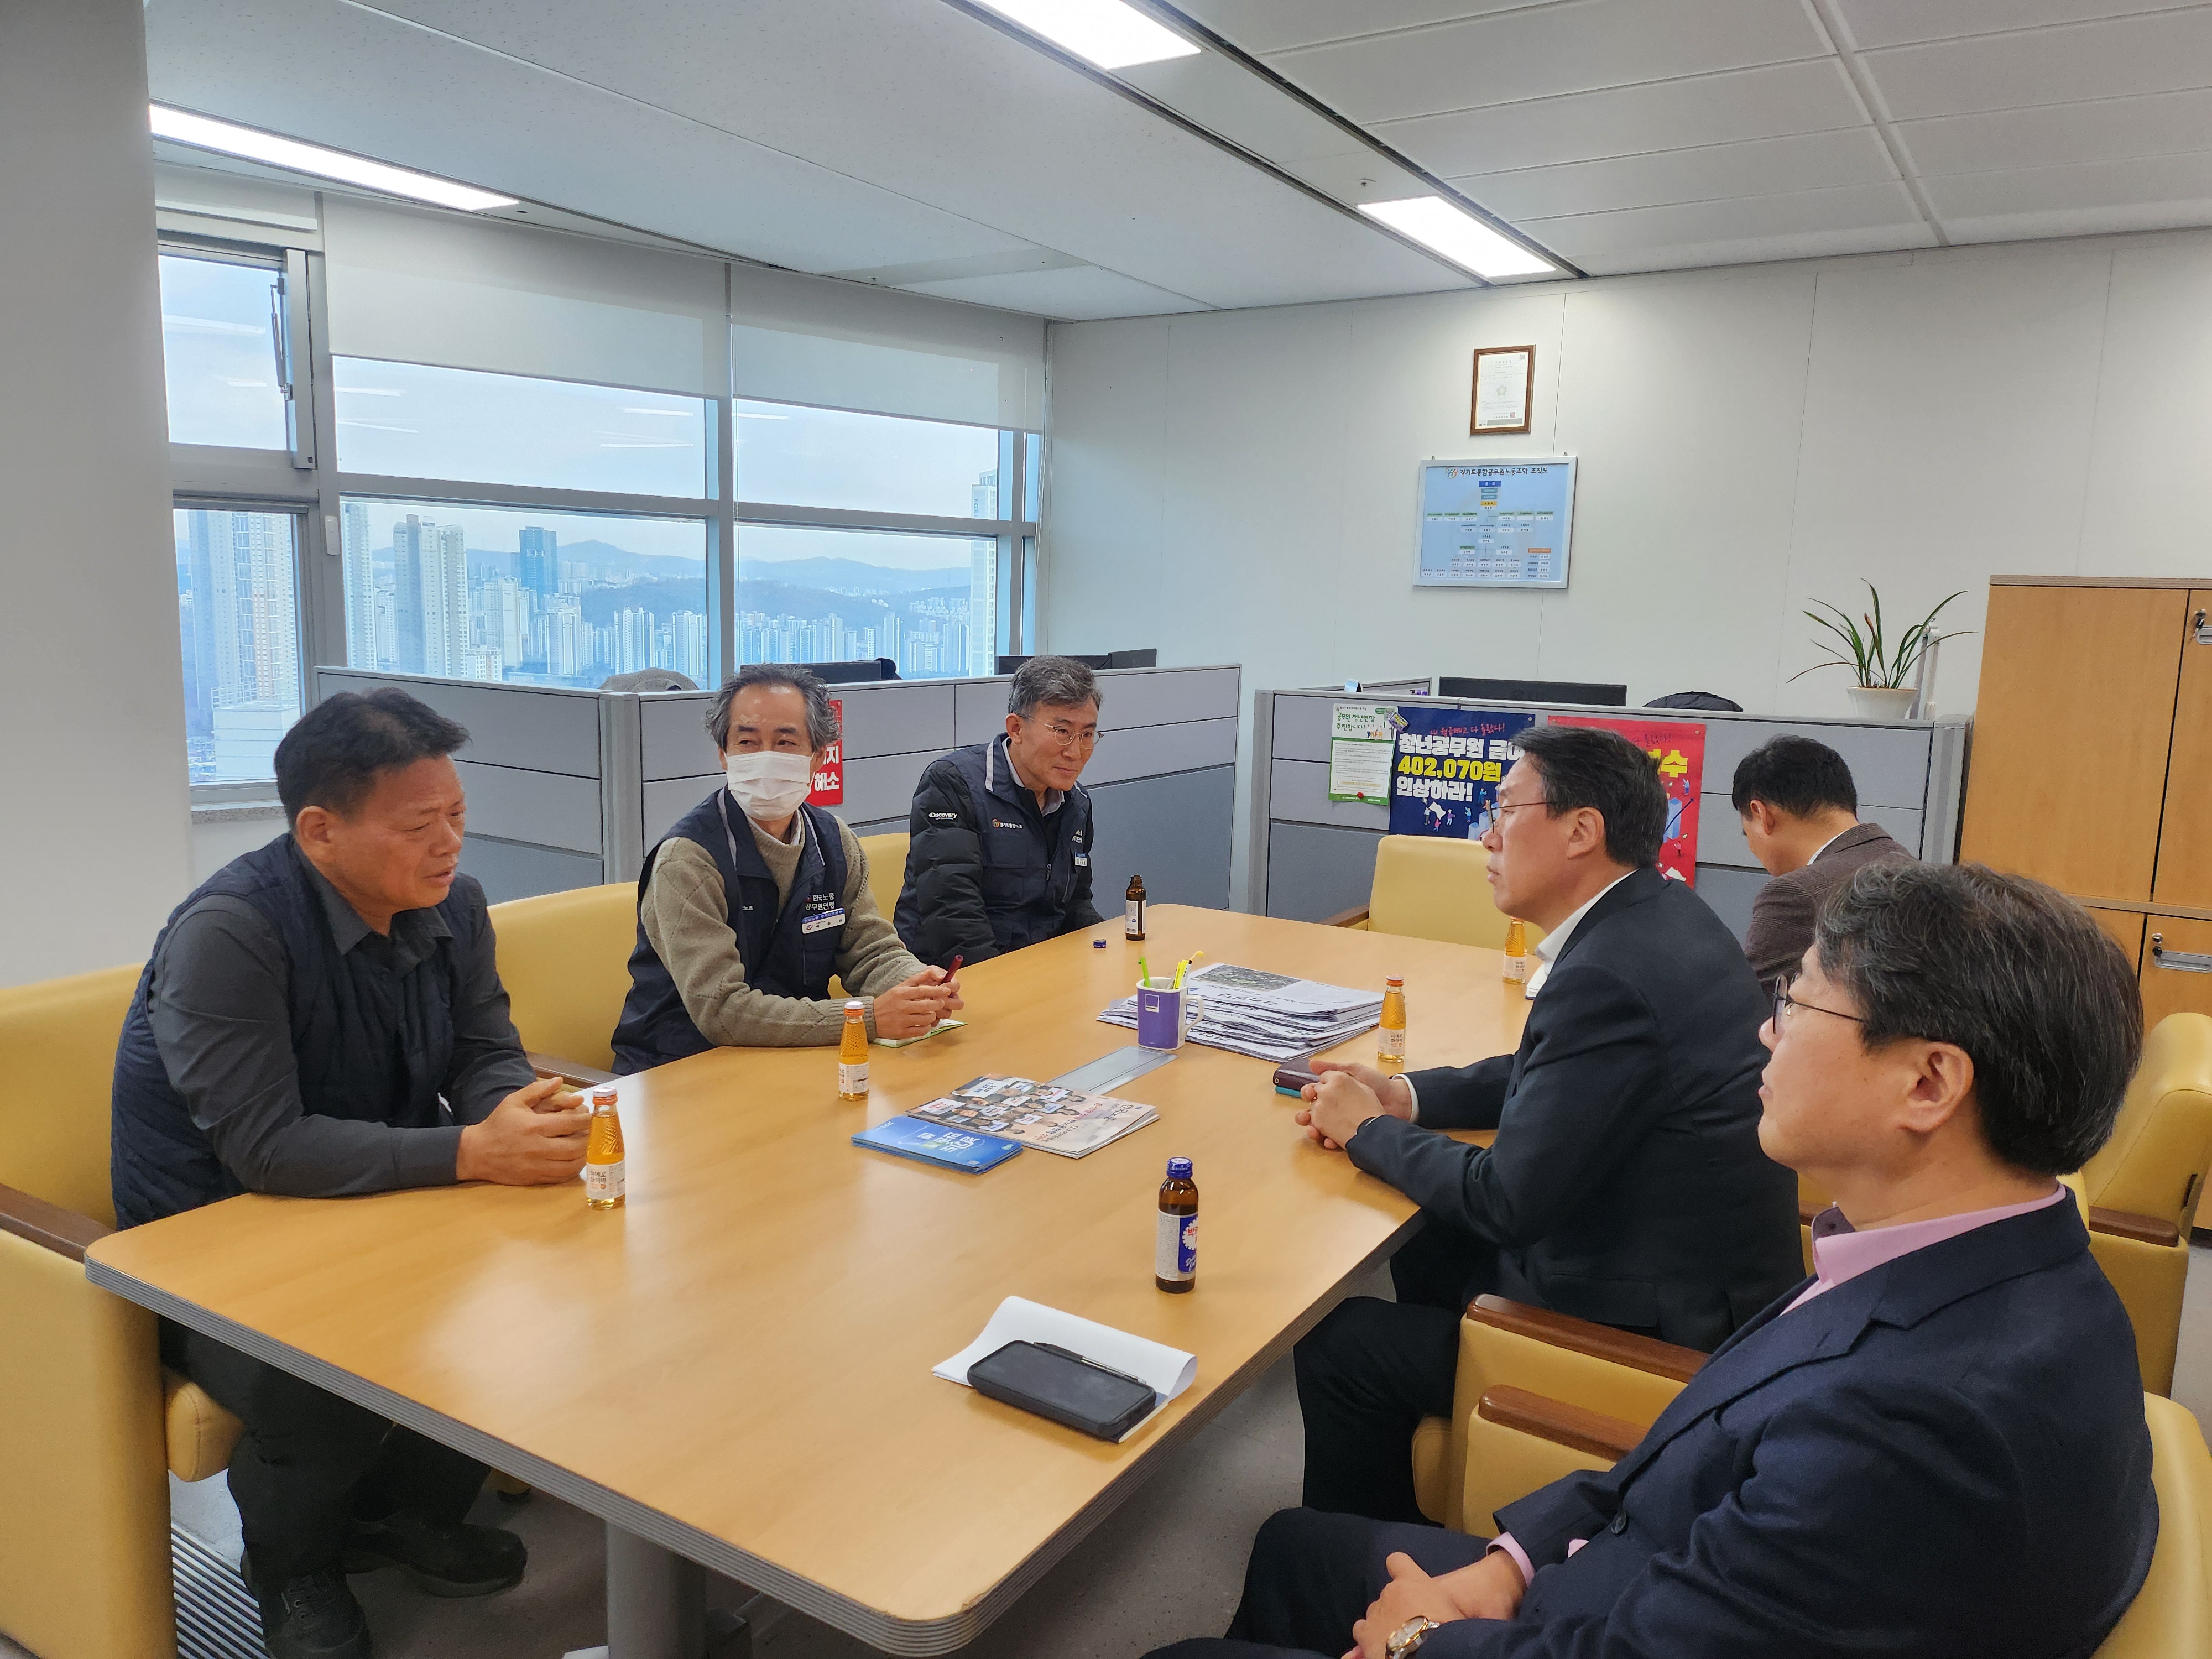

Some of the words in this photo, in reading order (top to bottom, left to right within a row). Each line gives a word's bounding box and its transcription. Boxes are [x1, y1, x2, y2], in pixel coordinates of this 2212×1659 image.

[1459, 467, 1528, 477] 경기도통합공무원노동조합
[1337, 712, 1350, 722] 공무원
[1352, 713, 1375, 723] 정년연장
[1337, 723, 1365, 732] 추진합니다!
[1470, 726, 1478, 734] 다
[1399, 733, 1484, 759] 청년공무원
[823, 745, 839, 765] 지
[1397, 755, 1502, 782] 402,070원
[814, 771, 839, 791] 해소
[1396, 776, 1474, 802] 인상하라!
[813, 892, 835, 902] 한국노총
[805, 901, 835, 911] 공무원연맹
